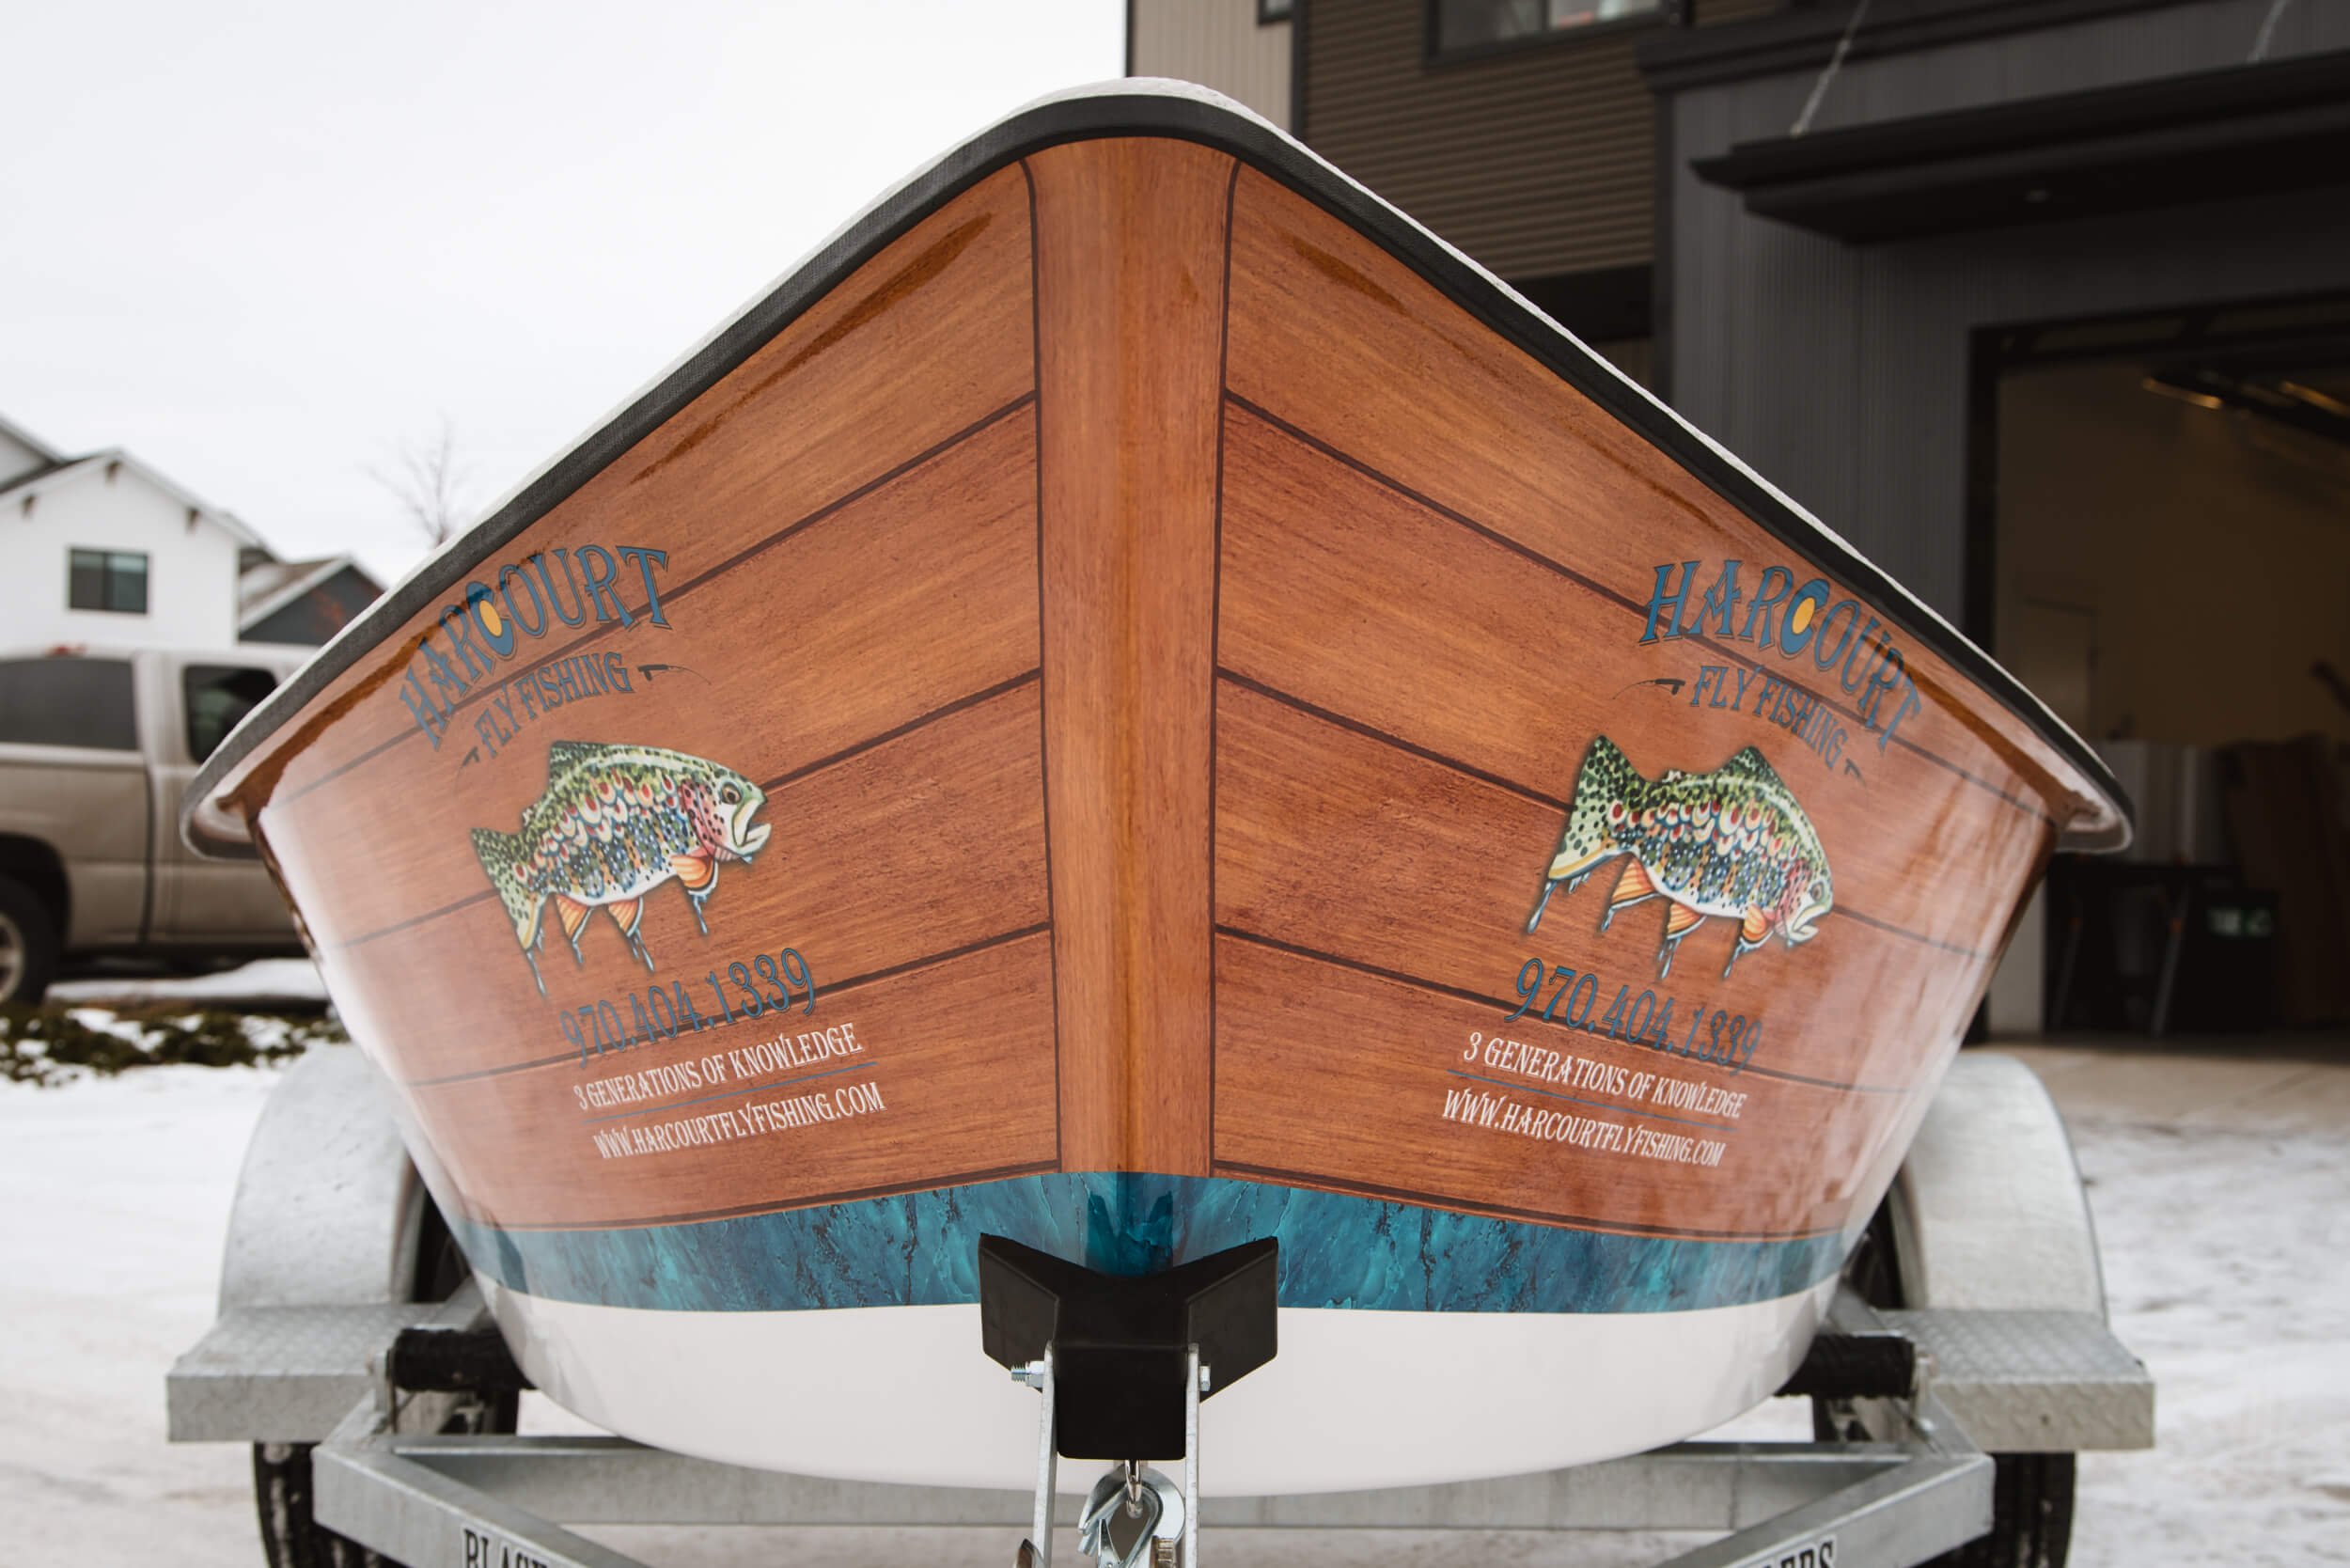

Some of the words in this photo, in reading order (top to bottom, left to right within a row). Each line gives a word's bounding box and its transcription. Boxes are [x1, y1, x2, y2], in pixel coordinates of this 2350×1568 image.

[399, 544, 673, 751] HARCOURT
[1638, 558, 1921, 751] HARCOURT
[474, 682, 523, 760] FLY
[521, 651, 634, 722] FISHING
[1689, 666, 1763, 712] FLY
[1752, 676, 1849, 769] FISHING
[559, 948, 815, 1068] 970.404.1339
[1505, 958, 1763, 1076] 970.404.1339
[572, 1084, 588, 1110] 3
[585, 1060, 703, 1108] GENERATIONS
[700, 1055, 729, 1084] OF
[730, 1023, 865, 1079] KNOWLEDGE
[1464, 1031, 1482, 1062] 3
[1483, 1037, 1627, 1096] GENERATIONS
[1627, 1071, 1654, 1099] OF
[1650, 1076, 1747, 1120] KNOWLEDGE
[593, 1082, 887, 1159] WWW.HARCOURTFLYFISHING.COM
[1442, 1086, 1727, 1167] WWW.HARCOURTFLYFISHING.COM
